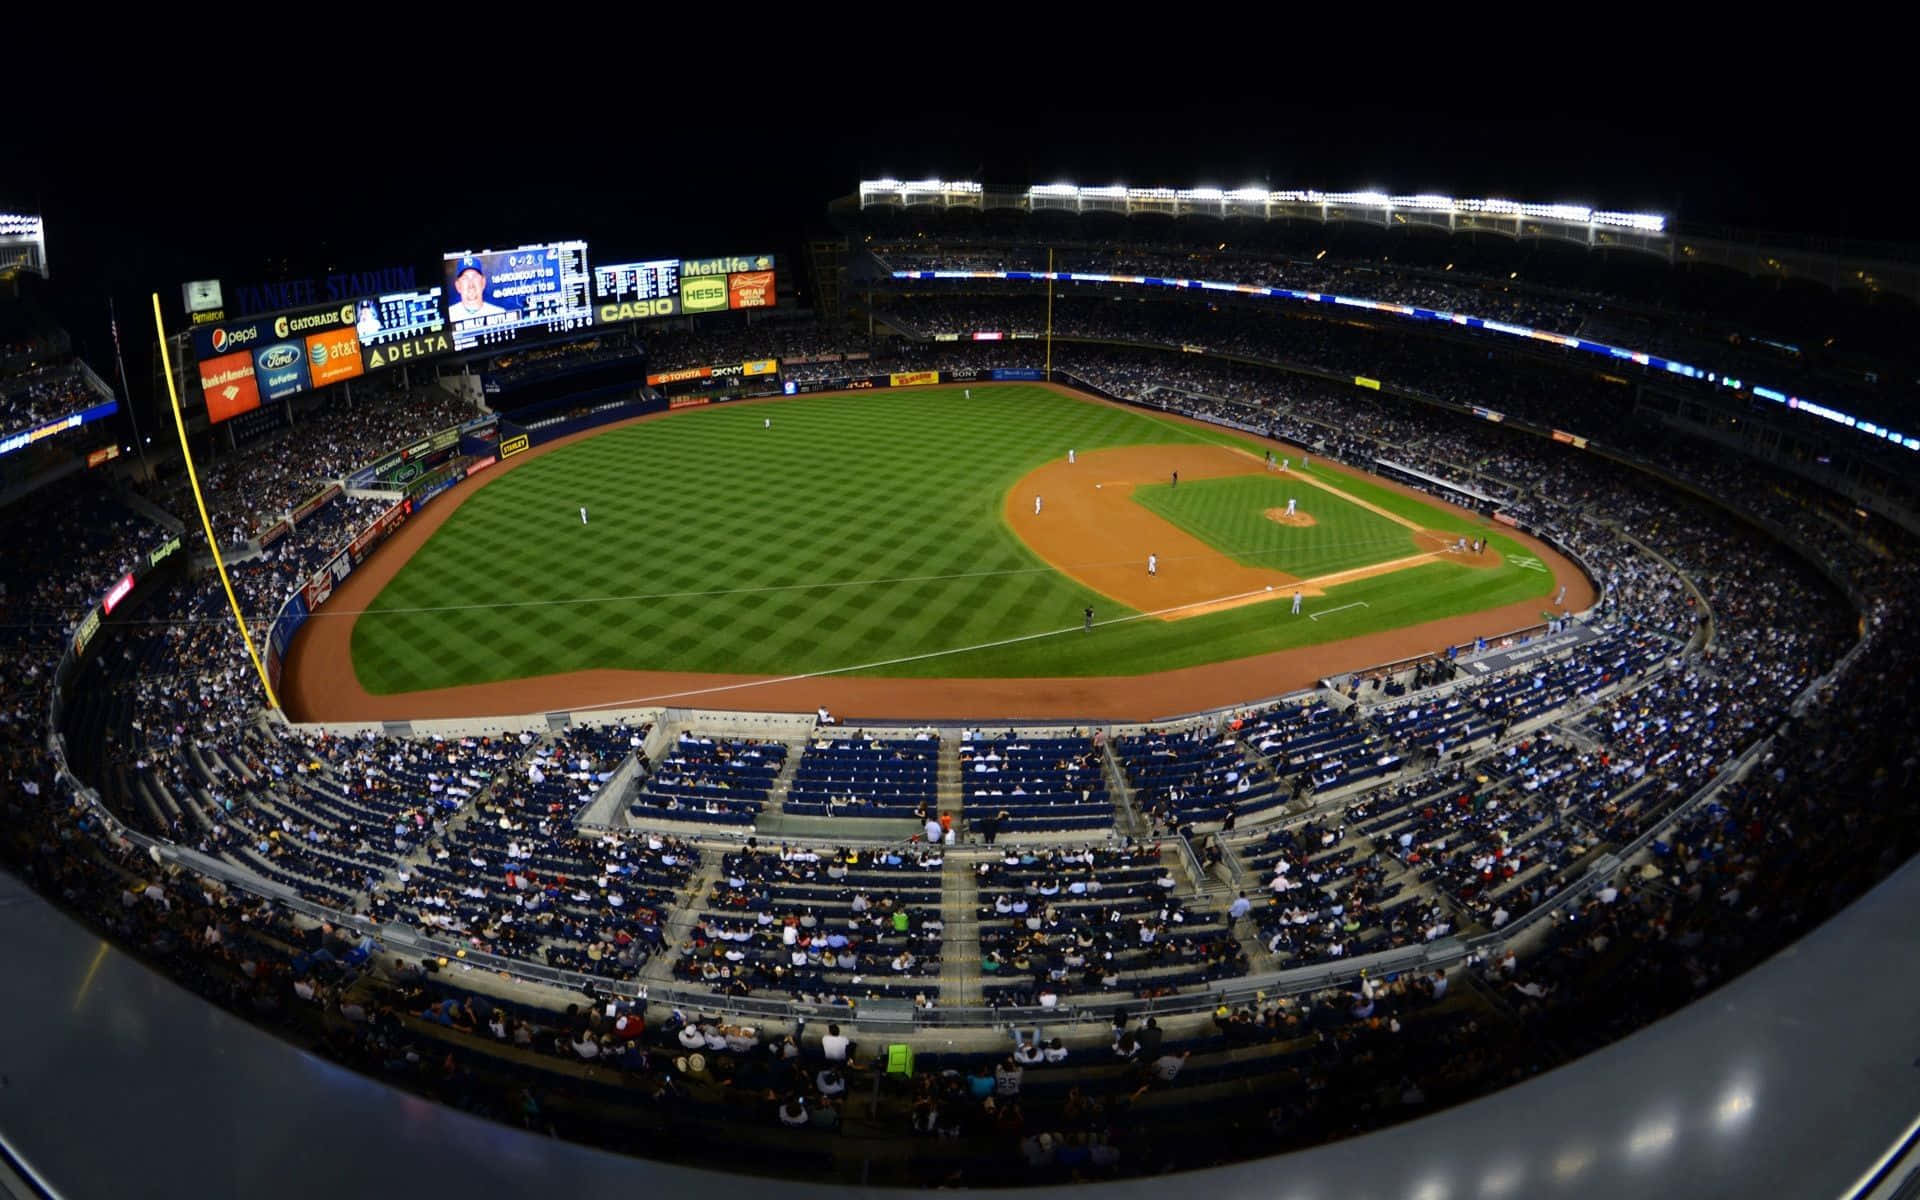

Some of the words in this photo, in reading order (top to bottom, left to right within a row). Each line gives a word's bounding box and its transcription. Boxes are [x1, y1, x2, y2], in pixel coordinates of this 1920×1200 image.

[684, 257, 749, 276] MetLife
[685, 287, 724, 300] HESS
[600, 298, 674, 323] CASIO
[290, 310, 339, 332] GATORADE
[228, 325, 258, 346] pepsi
[331, 340, 357, 360] at&t
[388, 336, 448, 362] DELTA
[266, 349, 293, 369] Ford
[226, 366, 255, 381] America
[670, 369, 702, 382] TOYOTA
[503, 441, 526, 454] STANLEY
[999, 1077, 1016, 1089] 25
